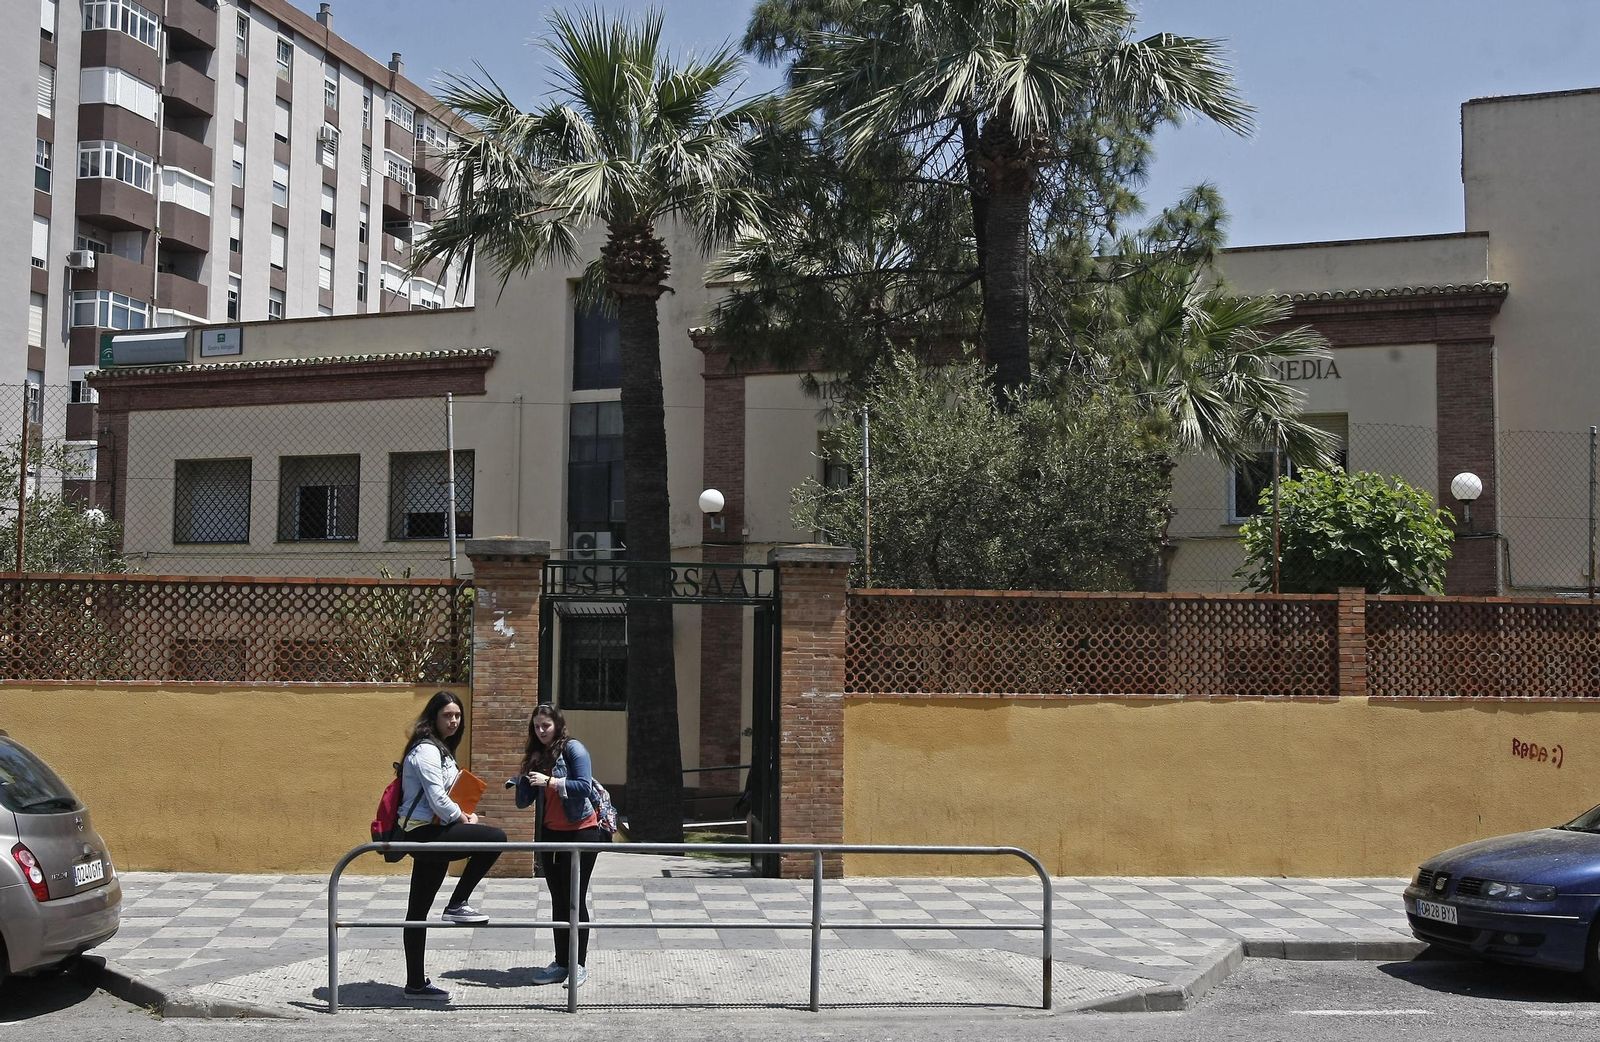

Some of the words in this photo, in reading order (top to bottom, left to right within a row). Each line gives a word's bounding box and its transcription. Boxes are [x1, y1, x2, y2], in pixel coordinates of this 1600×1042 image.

[1271, 359, 1342, 381] MEDIA
[549, 566, 597, 596] IES
[609, 566, 773, 598] KRSAAL
